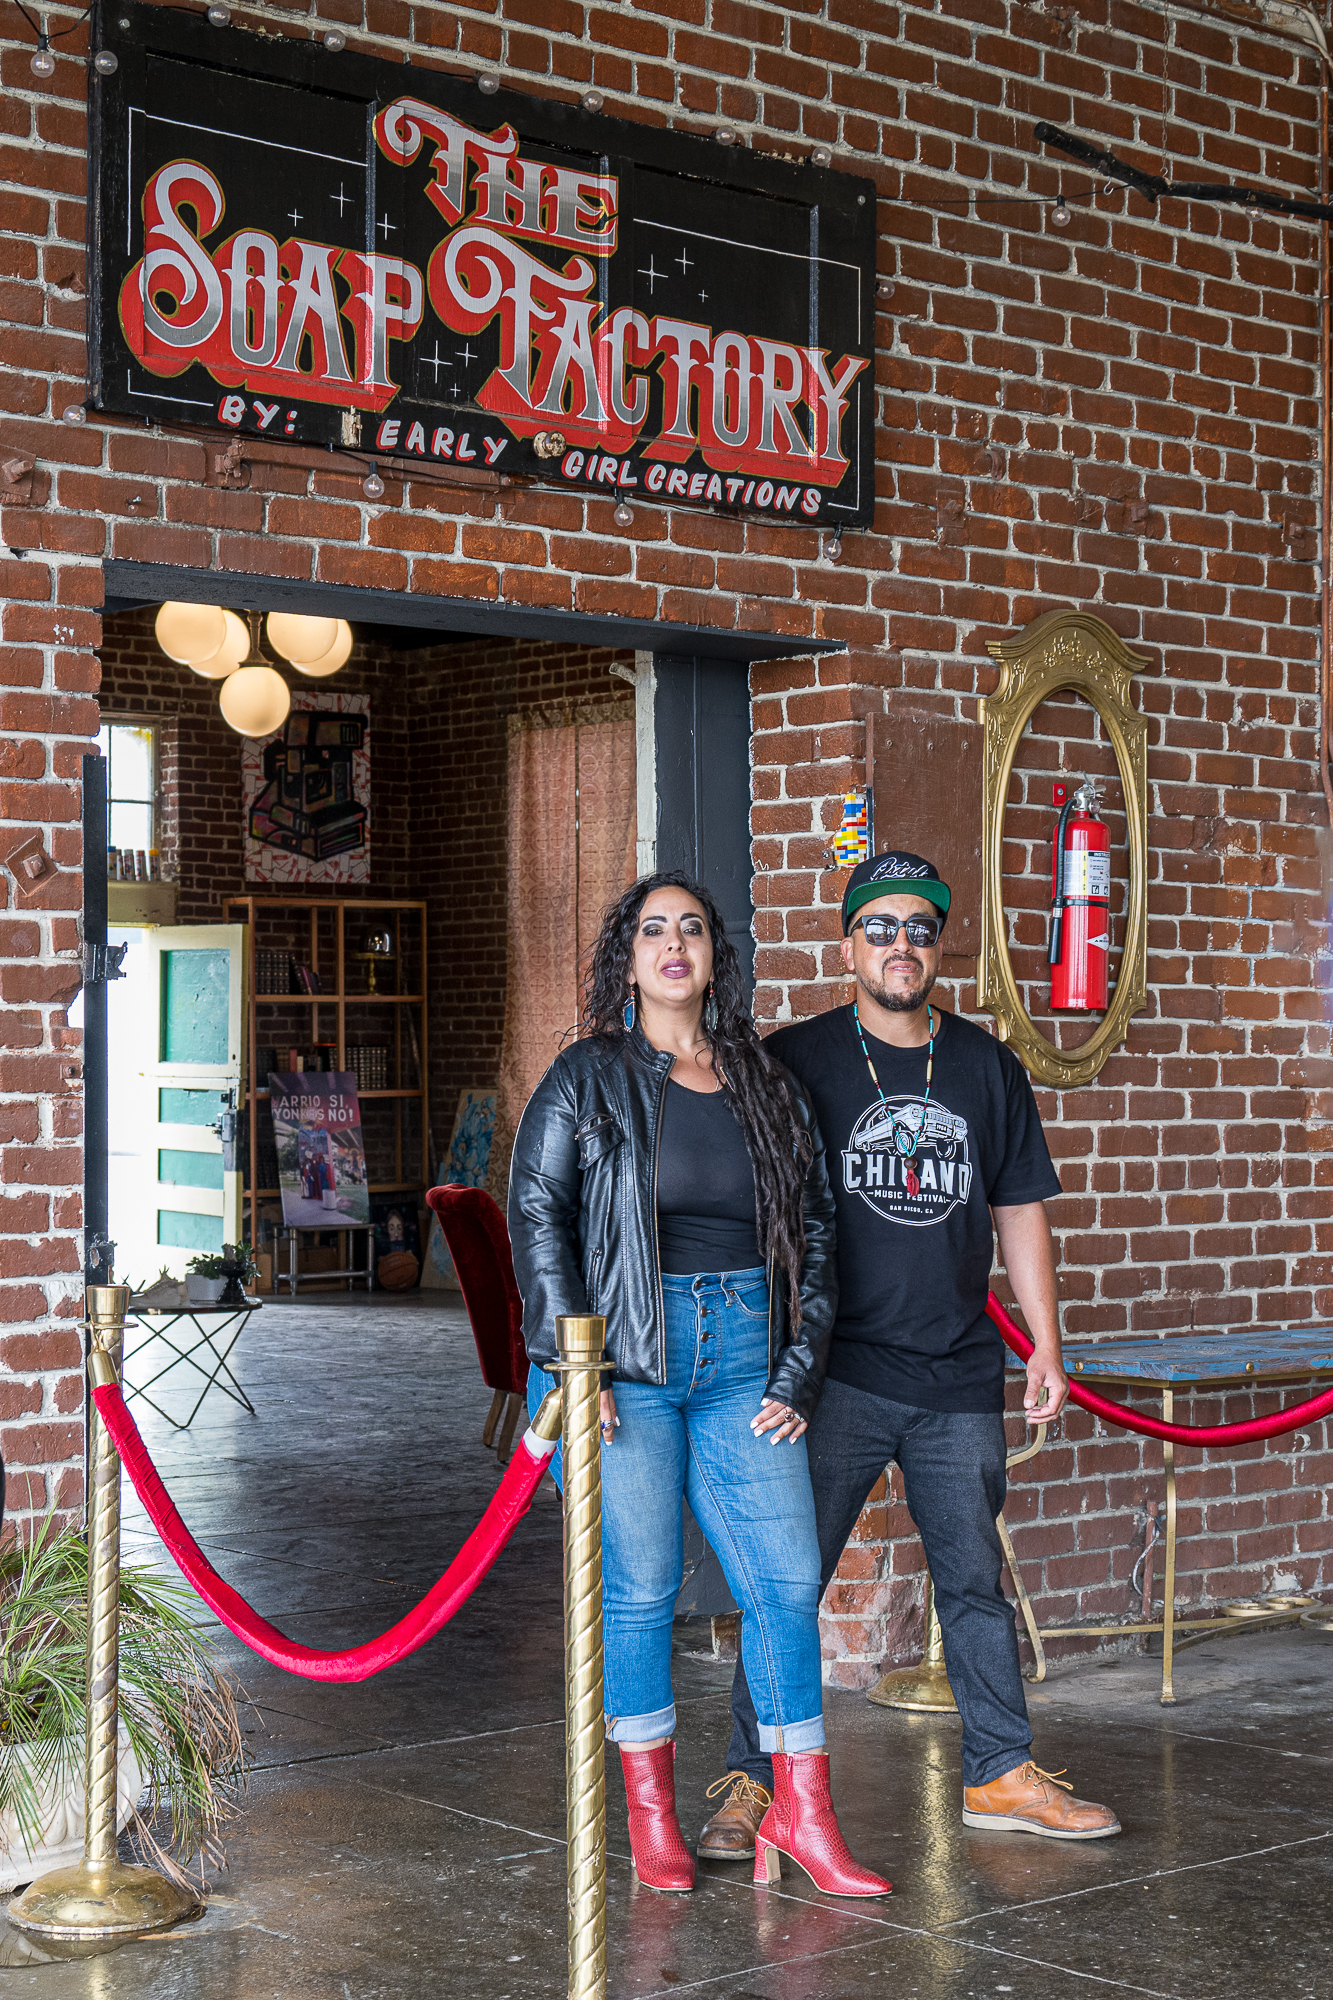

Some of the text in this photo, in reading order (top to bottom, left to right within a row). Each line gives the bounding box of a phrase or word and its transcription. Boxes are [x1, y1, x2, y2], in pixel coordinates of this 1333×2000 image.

[376, 97, 618, 252] THE
[126, 161, 868, 472] SOAP FACTORY
[218, 395, 822, 516] BY: EARLY GIRL CREATIONS
[328, 1108, 354, 1122] NO!
[874, 1189, 903, 1199] MUSIC
